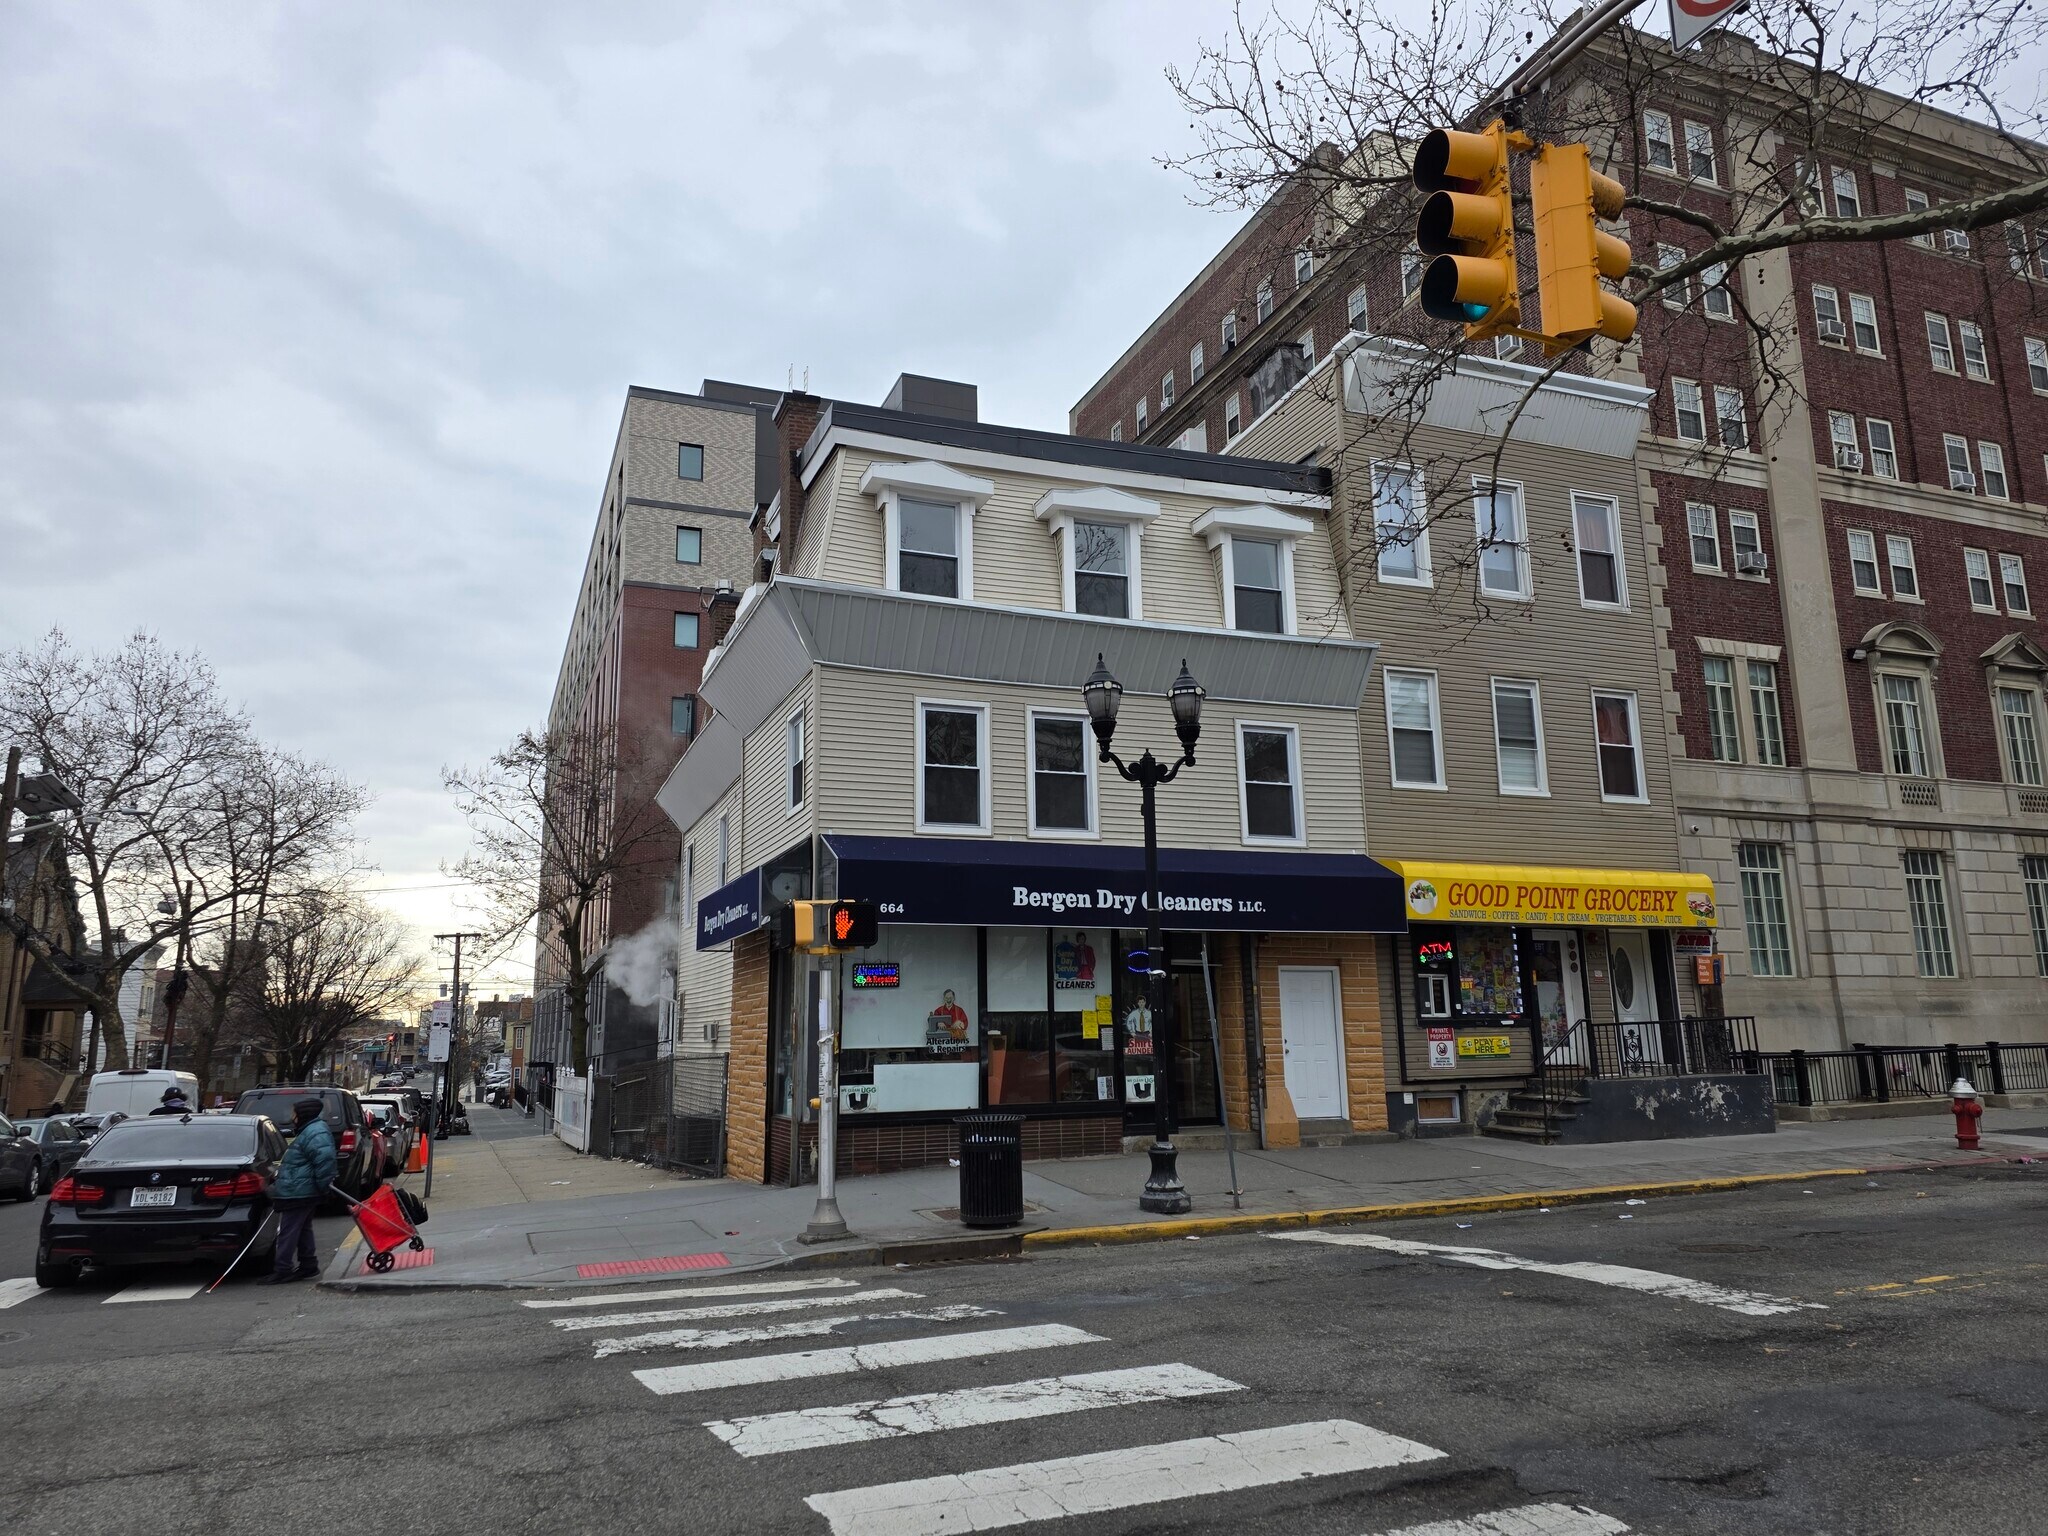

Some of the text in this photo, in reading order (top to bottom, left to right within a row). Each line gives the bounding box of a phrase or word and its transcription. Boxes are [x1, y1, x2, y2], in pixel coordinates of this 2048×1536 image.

[1013, 886, 1092, 912] Bergen
[1097, 889, 1136, 915] Dry
[1238, 901, 1266, 912] LLC.
[1448, 883, 1678, 912] GOOD POINT GROCERY
[880, 903, 904, 914] 664
[1449, 909, 1682, 924] SANDWICH COFFEE CANDY ICE CREAM VEGETABLES SODA JUICE
[1675, 934, 1711, 946] ATM
[1420, 942, 1452, 955] ATM
[857, 966, 897, 976] Alterations
[873, 975, 897, 984] Repairs
[1056, 981, 1095, 989] CLEANERS
[926, 1037, 970, 1045] Alterations
[1129, 1038, 1152, 1048] Shirt
[1473, 1038, 1494, 1046] PLAY
[937, 1045, 966, 1054] Repairs
